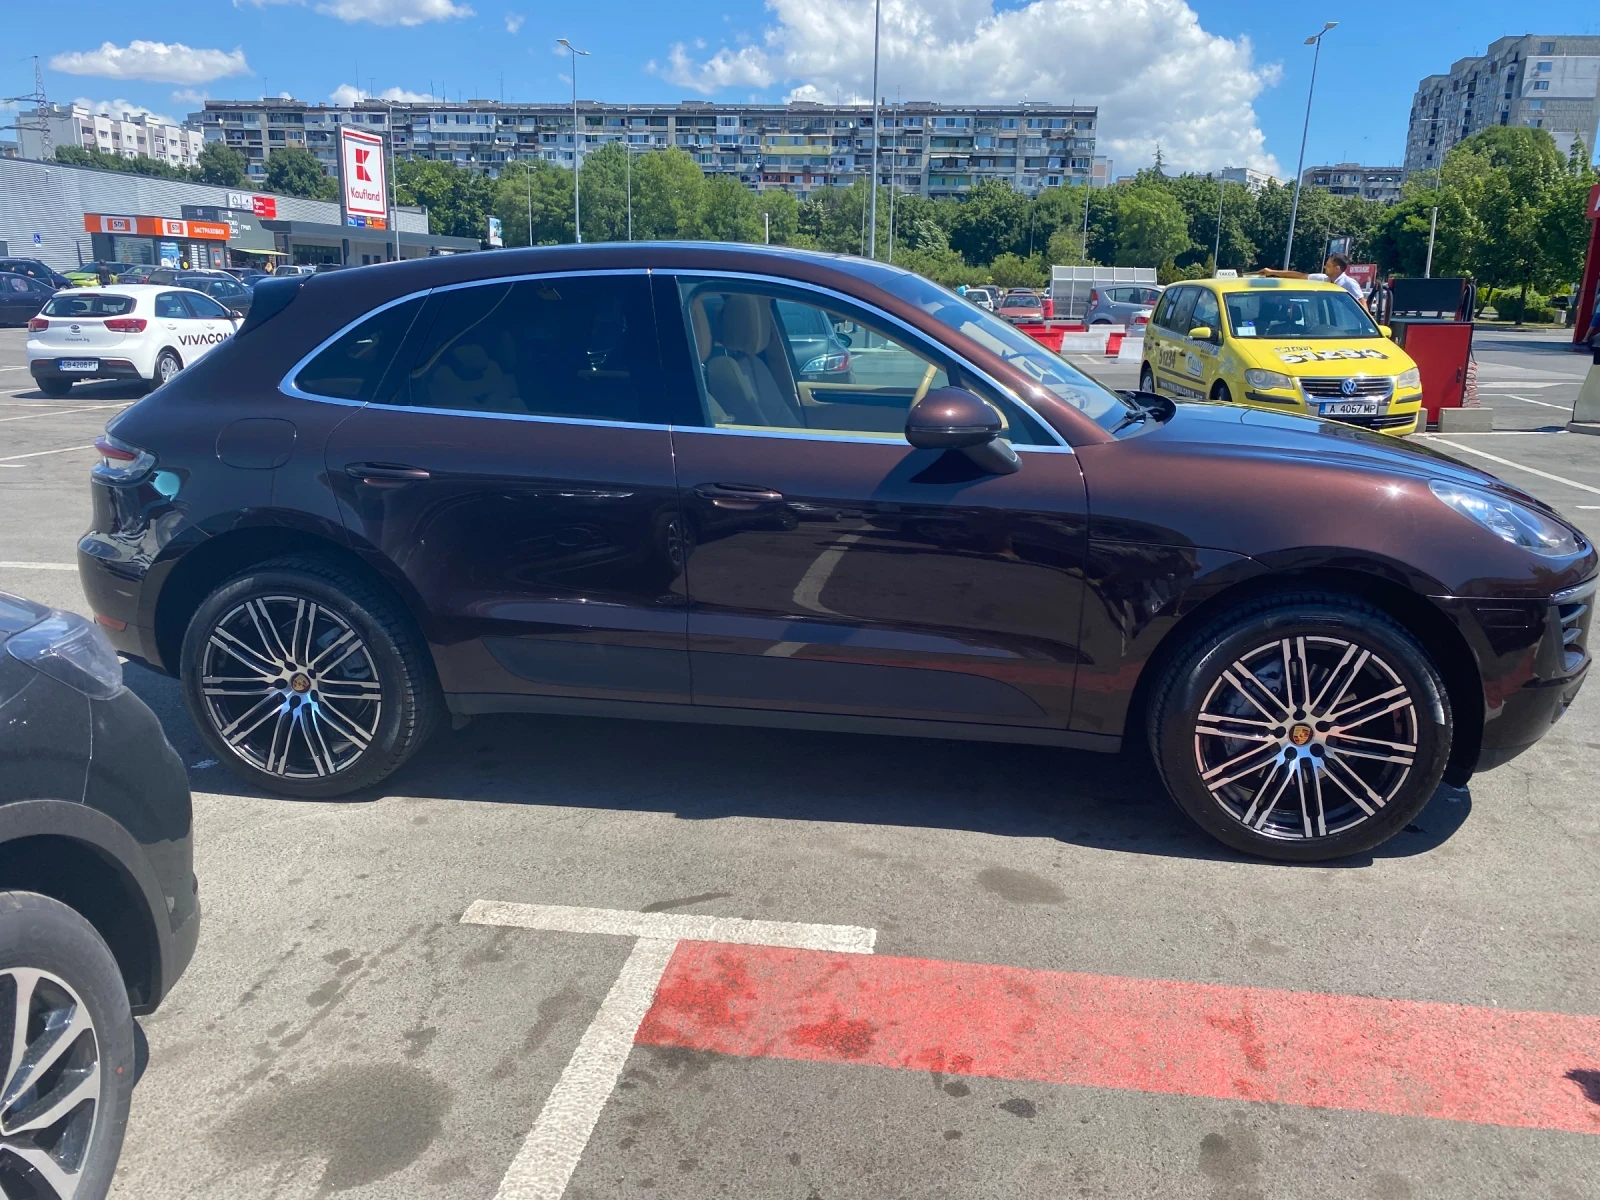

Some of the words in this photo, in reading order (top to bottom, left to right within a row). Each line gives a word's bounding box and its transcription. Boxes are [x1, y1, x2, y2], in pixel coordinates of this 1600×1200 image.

[350, 187, 380, 202] Kaufland
[193, 226, 225, 236] ЗАСТРАХОВКИ
[1159, 349, 1176, 368] 51234
[1279, 348, 1389, 364] 51234
[1329, 404, 1336, 413] A
[1340, 404, 1361, 413] 4067
[1363, 404, 1376, 413] MP
